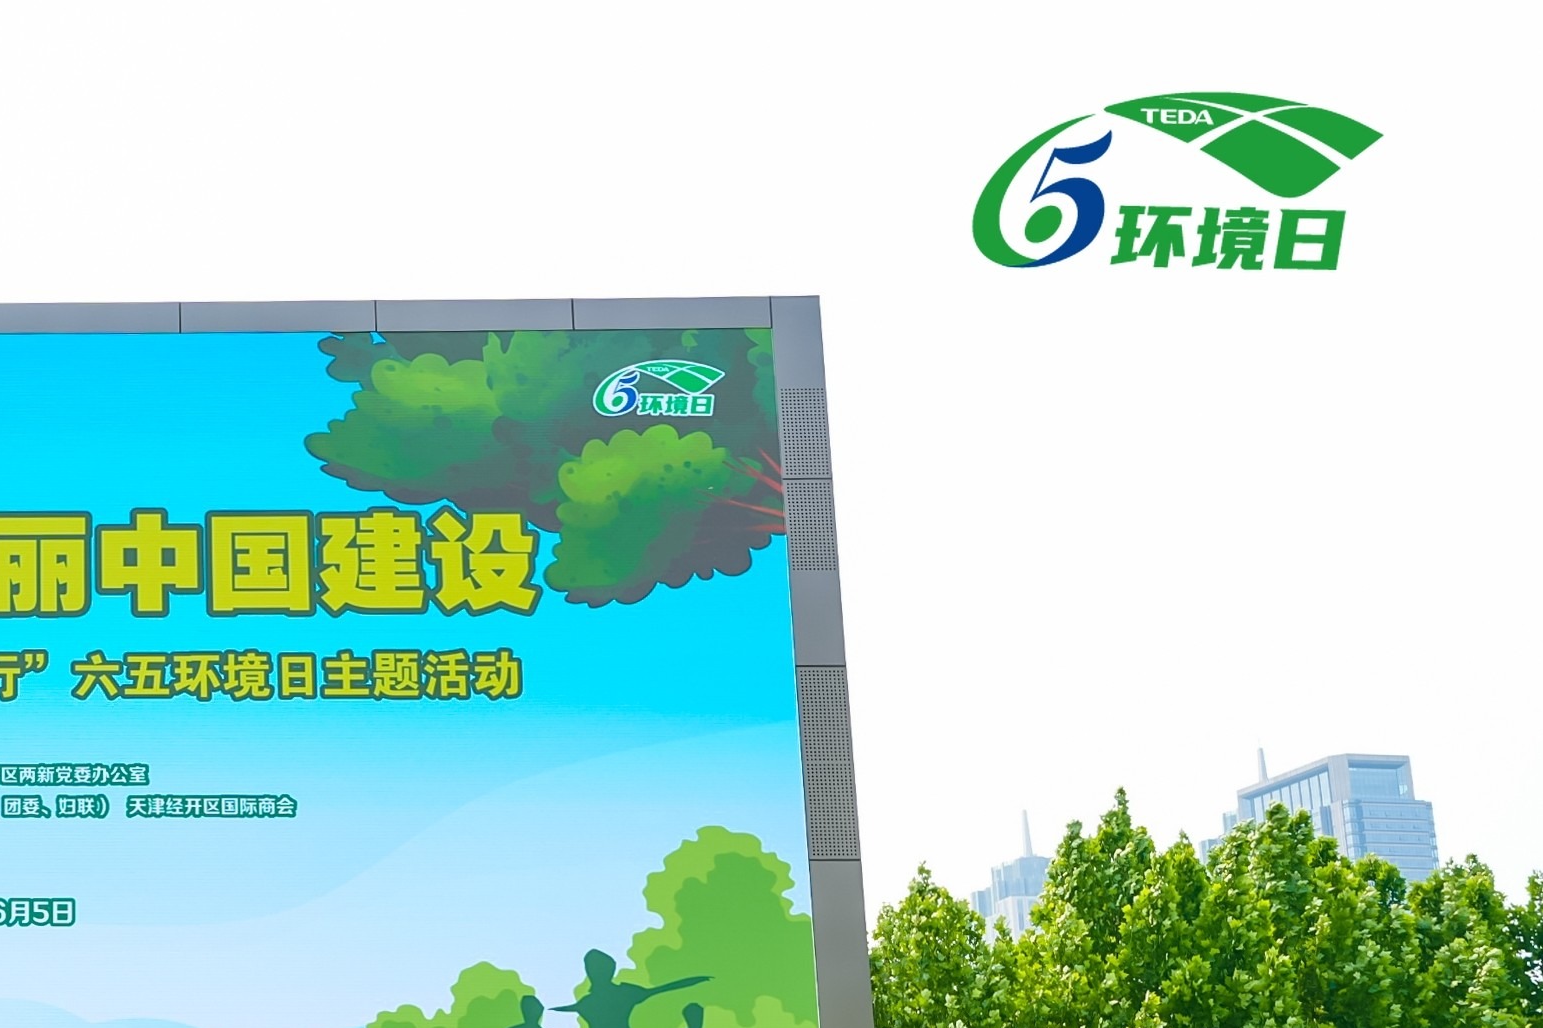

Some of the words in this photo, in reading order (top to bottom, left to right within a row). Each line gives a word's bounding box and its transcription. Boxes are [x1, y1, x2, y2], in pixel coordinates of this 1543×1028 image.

[638, 394, 714, 416] 环境日
[73, 650, 522, 701] 六五环境日主题活动
[127, 796, 296, 817] 天津经开区国际商会
